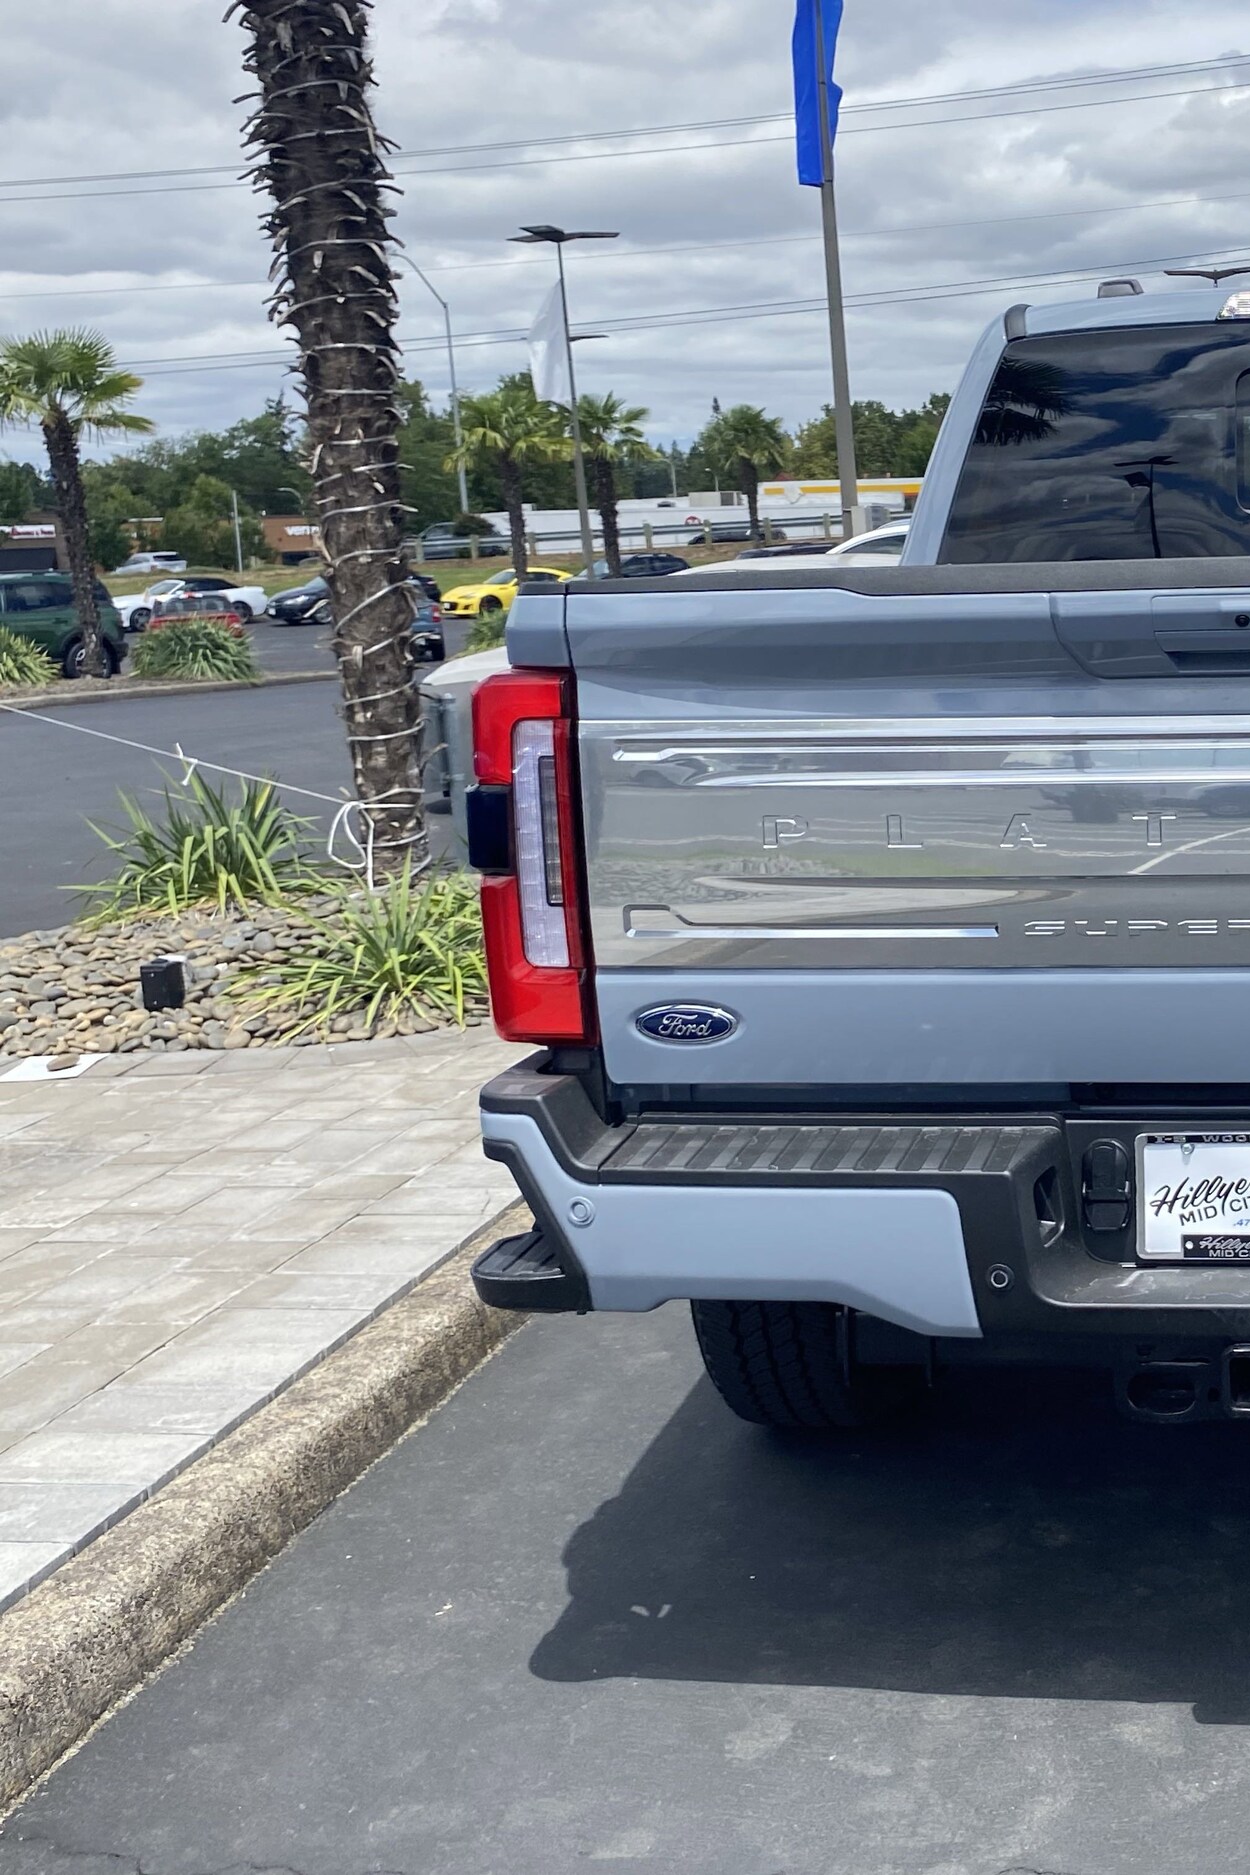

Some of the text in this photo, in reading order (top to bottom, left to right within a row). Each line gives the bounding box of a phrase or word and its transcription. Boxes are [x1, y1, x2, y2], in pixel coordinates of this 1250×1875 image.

[658, 1013, 713, 1036] Ford
[1178, 1205, 1218, 1226] MID
[1209, 1249, 1235, 1257] MID
